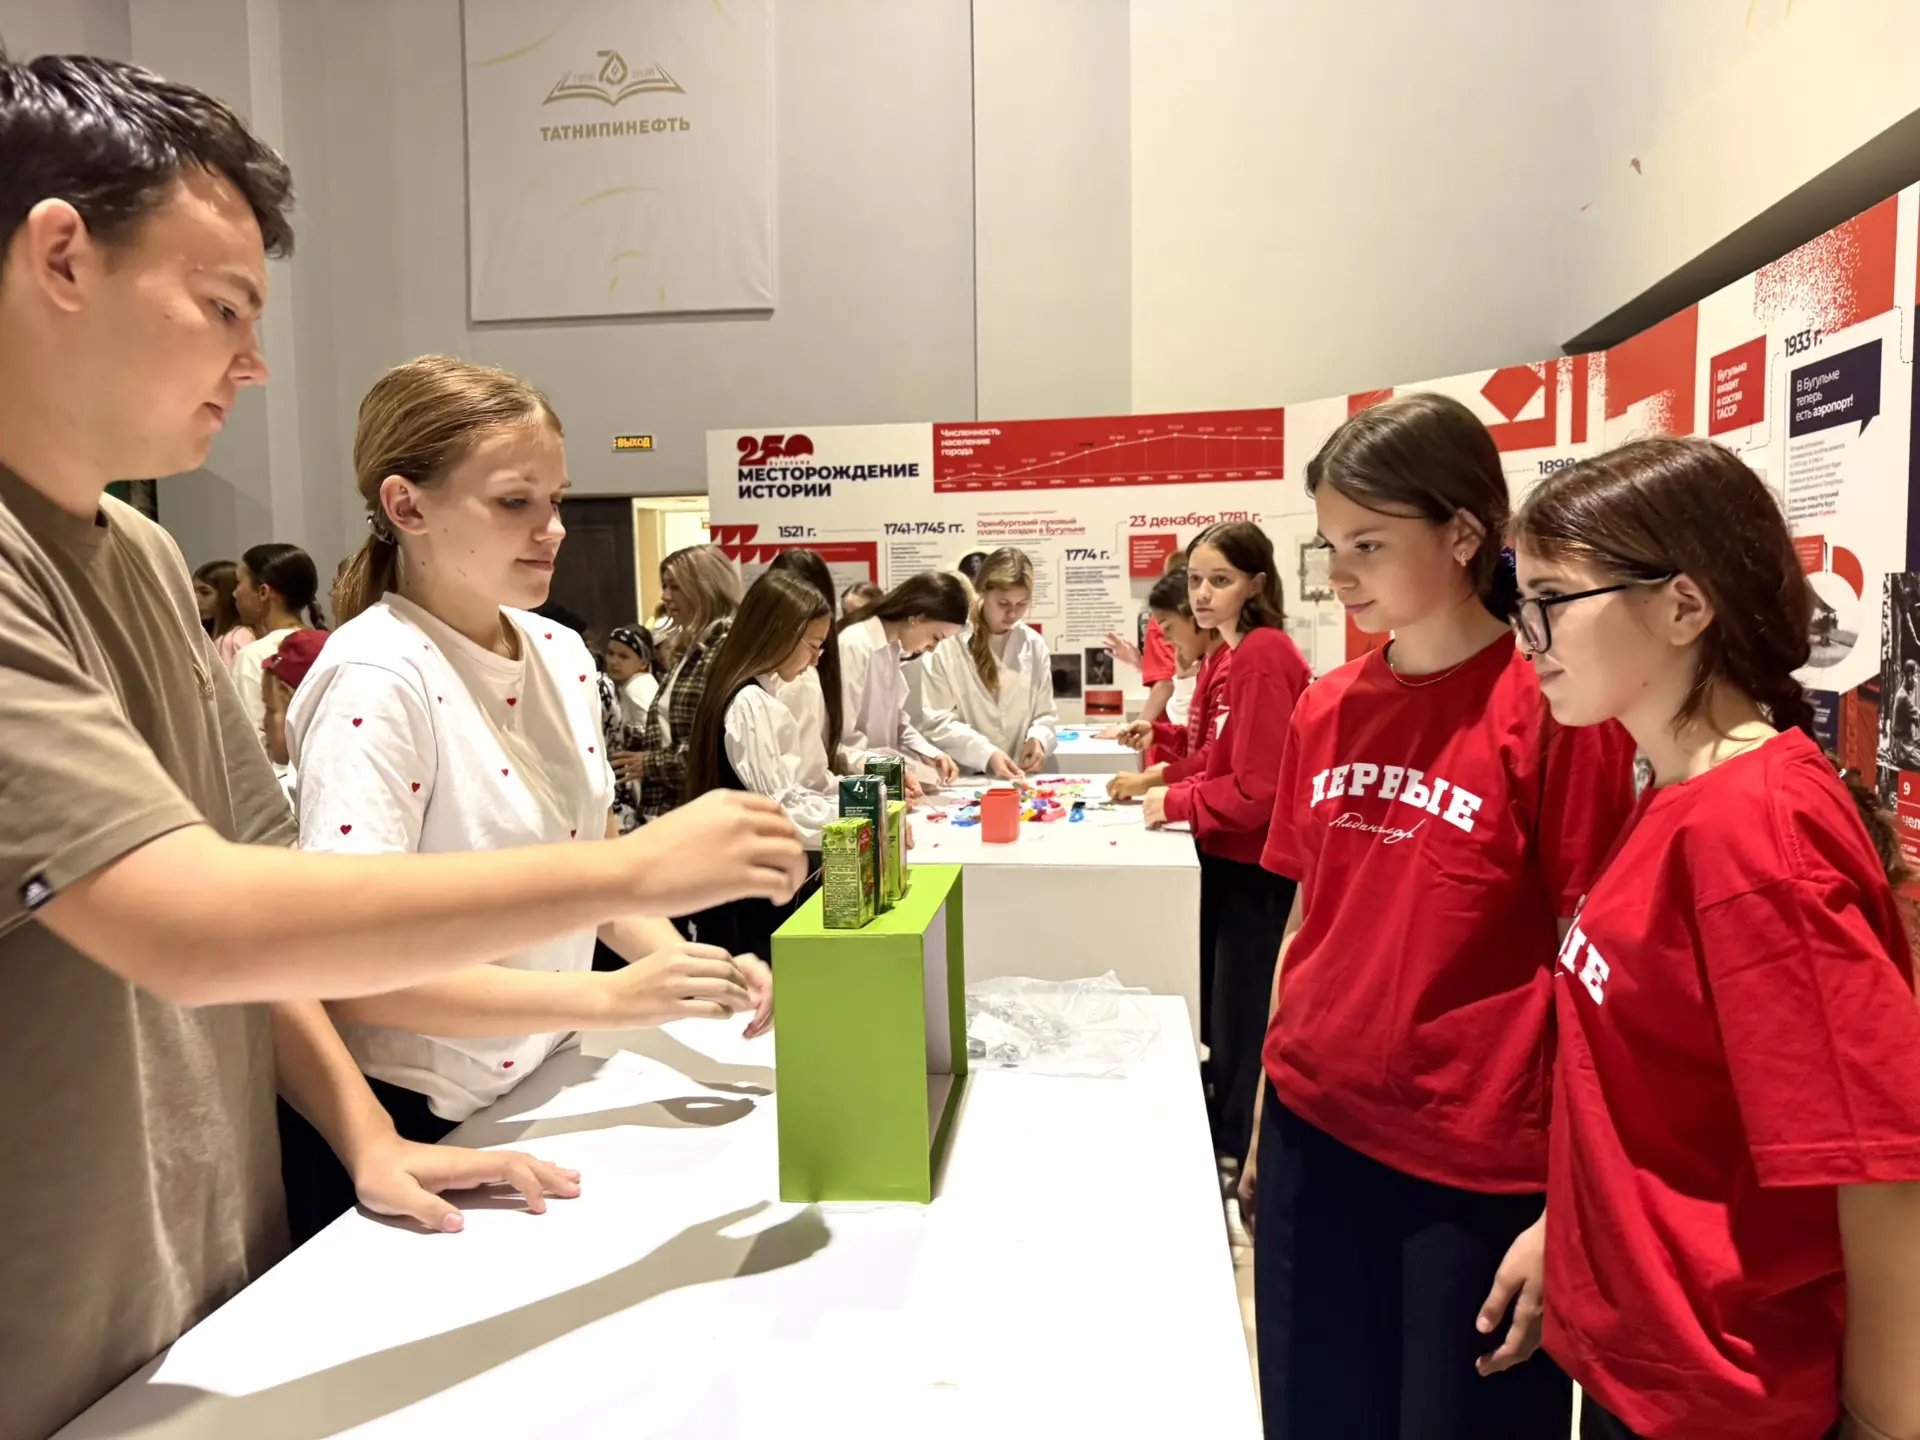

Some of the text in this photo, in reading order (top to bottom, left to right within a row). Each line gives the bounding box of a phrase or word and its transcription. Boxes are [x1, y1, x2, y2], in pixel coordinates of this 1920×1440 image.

[540, 116, 691, 141] ТАТНИПИНЕФТЬ
[1784, 328, 1823, 358] 1933 г.
[1796, 369, 1840, 392] В Бугульме
[1796, 391, 1823, 407] теперь
[1795, 393, 1854, 422] есть аэропорт!
[940, 427, 1002, 437] Численность
[736, 433, 814, 467] 250
[940, 438, 991, 447] населения
[940, 447, 974, 457] города
[738, 463, 920, 483] МЕСТОРОЖДЕНИЕ
[738, 482, 832, 499] ИСТОРИИ
[1129, 515, 1147, 528] 23
[1149, 512, 1215, 528] декабря
[778, 526, 817, 538] 1521 г.
[884, 522, 965, 536] 1741-1745 гг.
[1065, 549, 1110, 561] 1774 г.
[1903, 781, 1911, 796] 9
